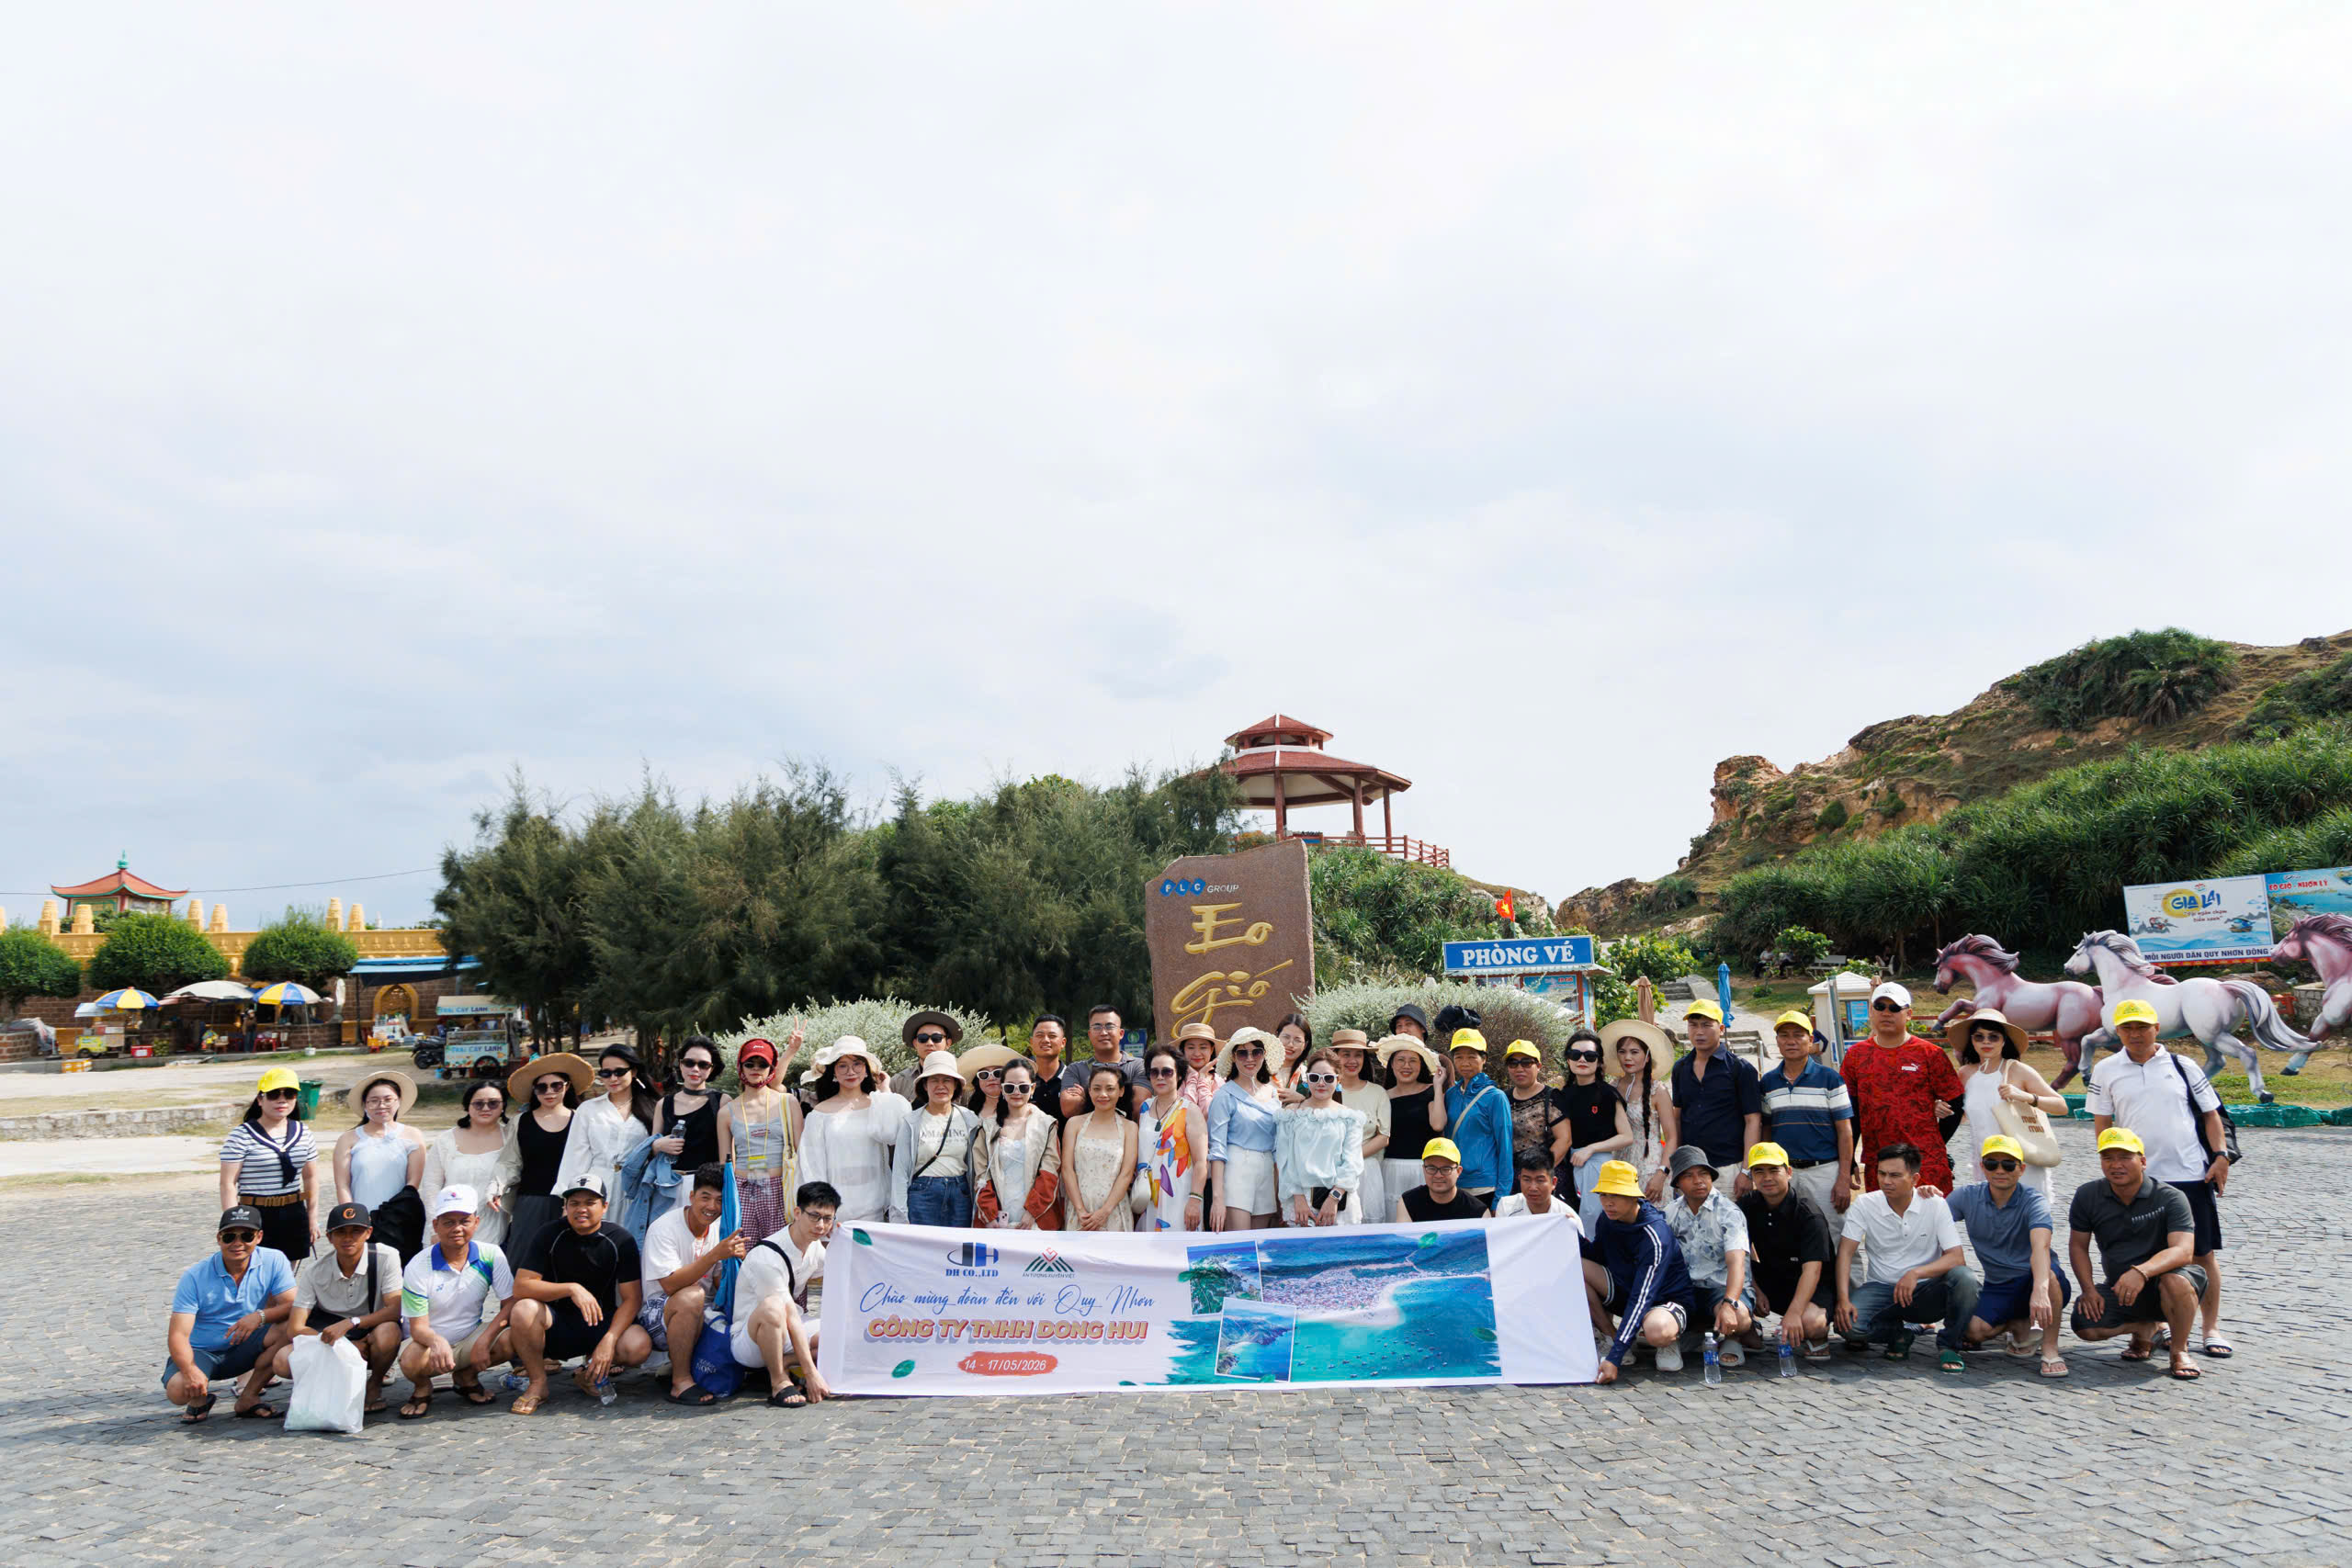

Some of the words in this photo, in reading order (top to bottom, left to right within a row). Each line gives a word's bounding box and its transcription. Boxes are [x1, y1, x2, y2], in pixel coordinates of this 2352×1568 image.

[1207, 884, 1239, 894] GROUP
[2171, 896, 2199, 909] GIA
[2201, 889, 2221, 908] LAI
[1184, 902, 1273, 955] Eo
[1462, 943, 1539, 966] PHÒNG
[1544, 940, 1576, 963] VÉ
[945, 1269, 959, 1277] DH
[860, 1282, 906, 1313] Chào
[914, 1291, 956, 1315] mừng
[957, 1286, 989, 1305] đoàn
[995, 1286, 1020, 1305] đến
[1027, 1292, 1046, 1305] với
[1054, 1284, 1102, 1316] Quy
[1106, 1285, 1156, 1314] Nhơn
[866, 1314, 935, 1339] CÔNG
[937, 1319, 969, 1339] TY
[970, 1319, 1035, 1340] TNHH
[1035, 1319, 1104, 1340] DONG
[1105, 1320, 1149, 1340] HUI
[965, 1359, 977, 1371] 14
[988, 1359, 1047, 1371] 17/05/2026
